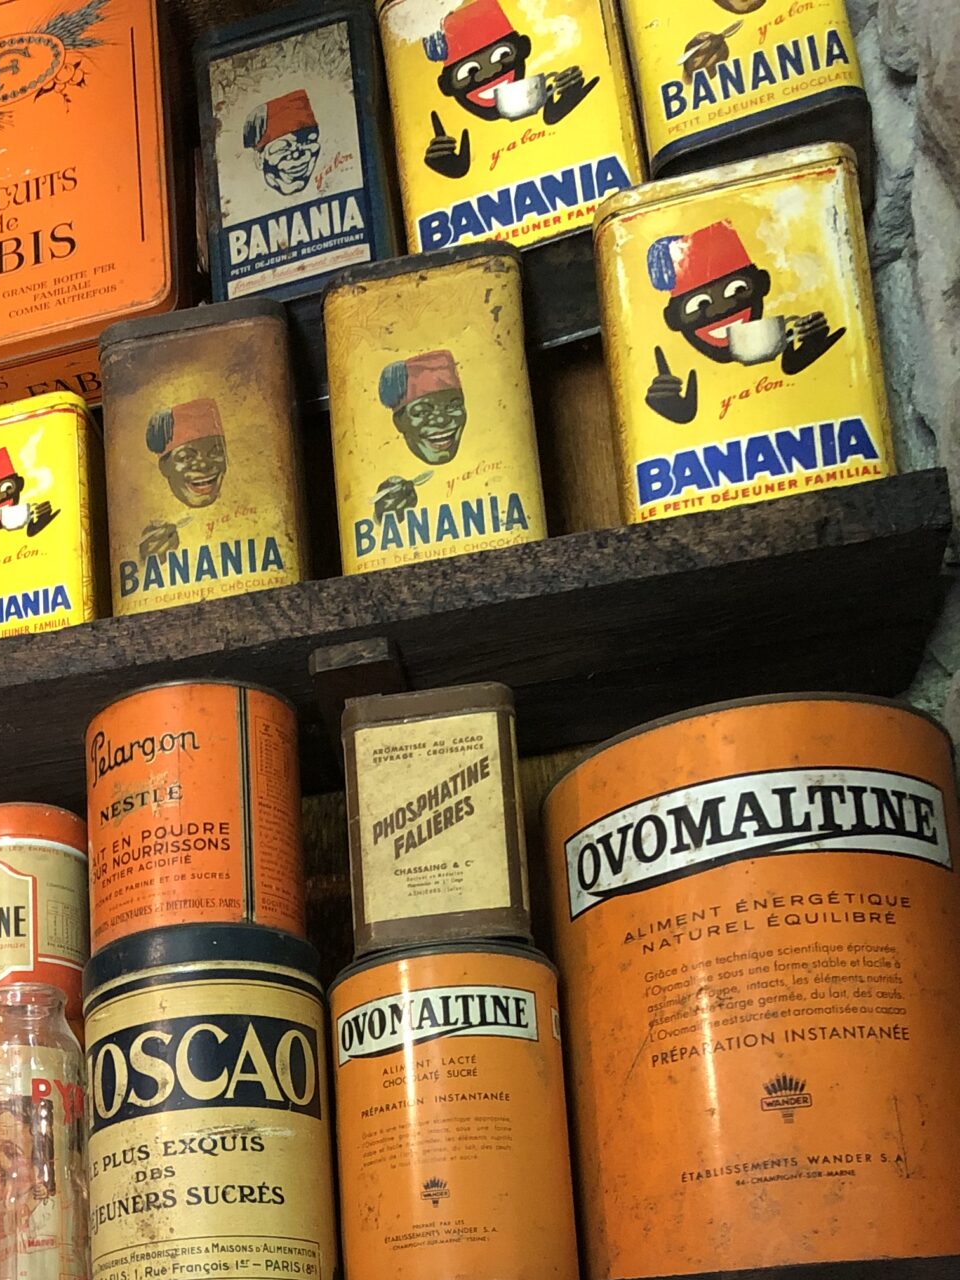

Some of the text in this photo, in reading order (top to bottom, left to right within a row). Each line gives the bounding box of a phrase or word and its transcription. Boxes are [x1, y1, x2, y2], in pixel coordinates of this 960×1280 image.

[660, 29, 849, 121] BANANIA
[668, 117, 701, 135] PETIT
[418, 155, 632, 251] BANANIA
[228, 196, 365, 266] BANANIA
[230, 233, 364, 276] PETIT RECONSTITUANT
[2, 281, 47, 300] GRANDE
[93, 263, 116, 276] FER
[33, 280, 91, 302] FAMILIALE
[8, 284, 117, 319] COMME AUTREFOIS
[636, 417, 879, 506] BANANIA
[641, 464, 881, 522] LE PETIT DÉJEUNER FAMILIAL
[354, 492, 529, 558] BANANIA
[119, 536, 284, 598] BANANIA
[357, 558, 387, 572] PETIT
[34, 617, 70, 632] FAMILIAL
[426, 743, 484, 756] CROISSANCE
[452, 735, 483, 745] CACAO
[91, 730, 200, 788] Pelargon
[372, 755, 490, 845] PHOSPHATINE
[112, 822, 230, 854] EN POUDRE
[394, 796, 475, 860] FALIÈRES
[576, 786, 938, 892] OVOMALTINE
[112, 838, 230, 869] NOURRISSONS
[102, 854, 192, 888] ENTIER ACIDIFIÉ
[125, 879, 155, 891] FARINE
[190, 872, 231, 880] SUCRES
[394, 863, 447, 876] CHASSAING
[219, 898, 240, 908] PARIS
[623, 889, 911, 944] ALIMENT ÉNERGÉTIQUE
[642, 909, 897, 955] NATUREL ÉQUILIBRÉ
[715, 950, 774, 964] technique
[777, 941, 843, 956] scientifique
[718, 956, 892, 980] sous une forme stable et facile
[792, 974, 809, 986] les
[814, 973, 863, 983] éléments
[810, 988, 825, 999] du
[853, 987, 872, 998] des
[341, 994, 529, 1052] OVOMALTINE
[781, 1008, 791, 1018] et
[792, 1004, 858, 1016] aromatisée
[861, 1005, 874, 1013] au
[441, 1055, 478, 1067] LACTÉ
[651, 1031, 776, 1068] PRÉPARATION
[784, 1024, 910, 1043] INSTANTANÉE
[89, 1022, 317, 1120] OSCAO
[447, 1066, 478, 1078] SUCRÉ
[434, 1091, 511, 1104] INSTANTANÉE
[763, 1096, 808, 1107] WANDER
[103, 1135, 265, 1172] PLUS EXQUIS
[681, 1153, 872, 1183] ÉTABLISSEMENTS WANDER
[135, 1165, 176, 1184] DES
[186, 1181, 285, 1206] SUCRÉS
[444, 1226, 478, 1235] WANDER
[145, 1266, 168, 1278] Rue
[172, 1262, 230, 1275] François
[265, 1260, 300, 1273] PARIS
